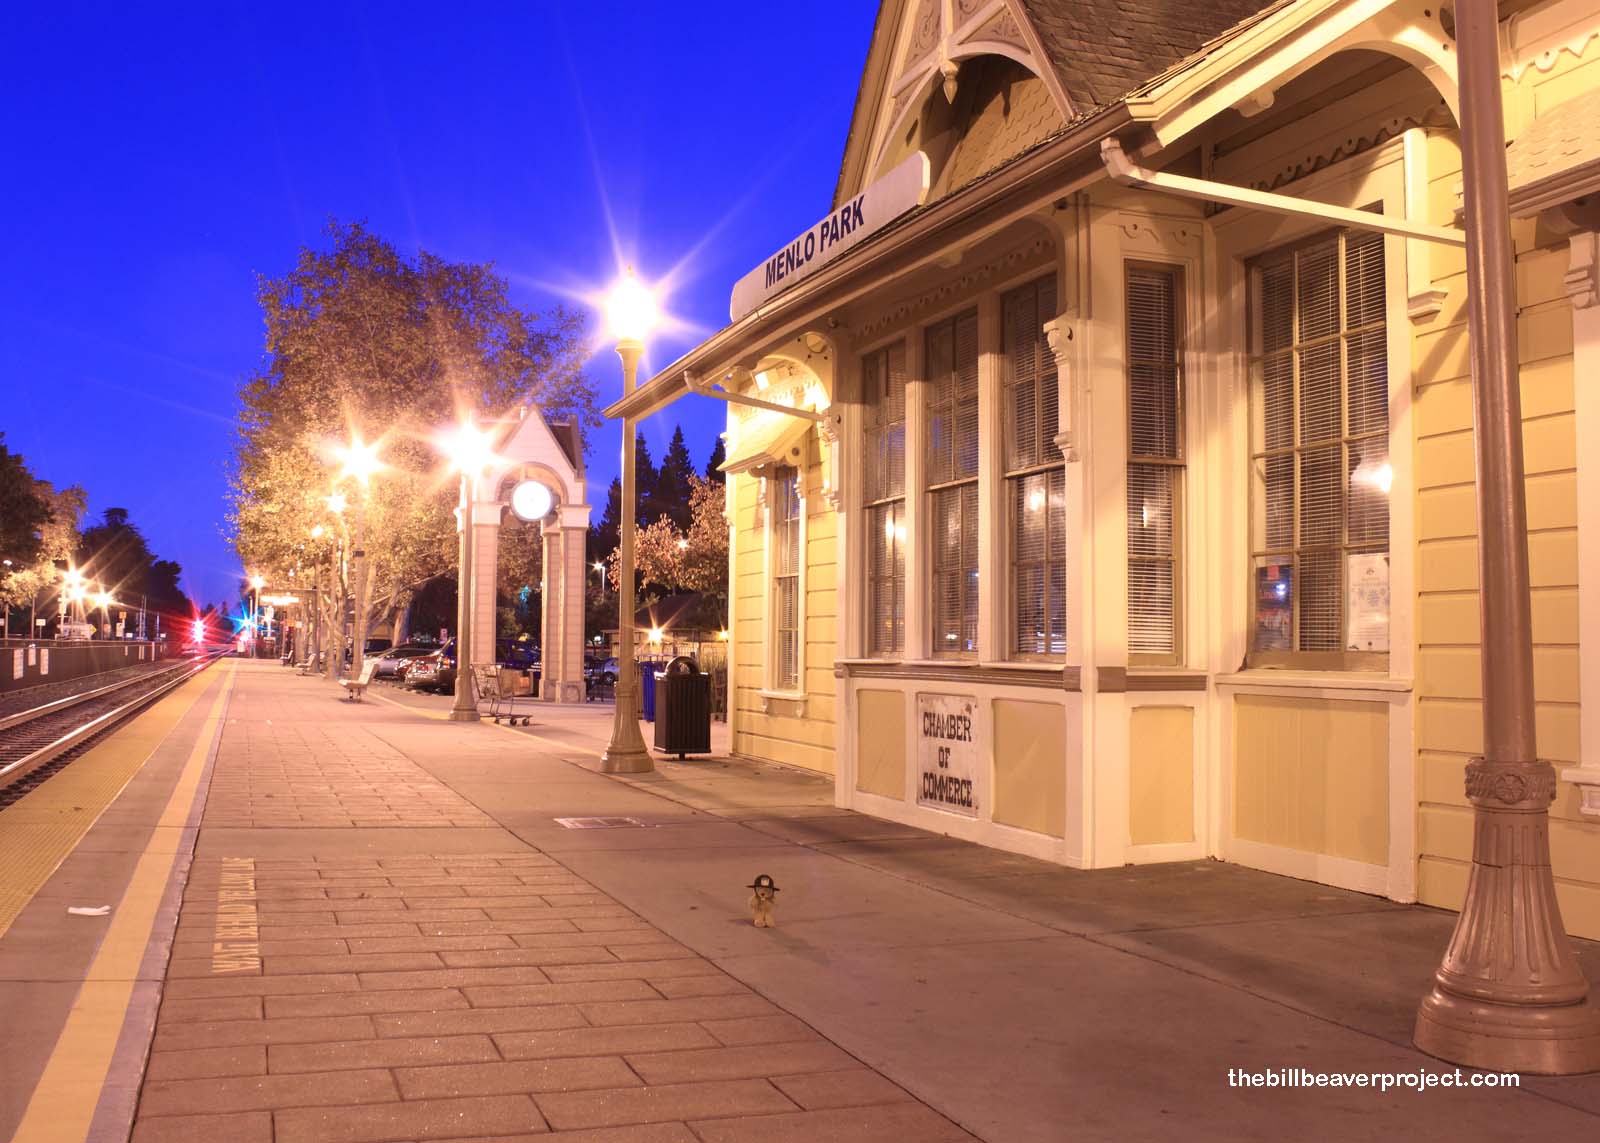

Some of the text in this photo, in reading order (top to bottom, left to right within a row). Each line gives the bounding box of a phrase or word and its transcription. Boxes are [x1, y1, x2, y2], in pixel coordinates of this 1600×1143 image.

[765, 195, 865, 288] MENLO PARK
[923, 712, 972, 742] CHAMBER
[938, 746, 951, 768] OF
[923, 772, 972, 808] COMMERCE
[218, 873, 256, 902] YELLOW
[215, 904, 259, 939] BEHIND
[211, 942, 261, 973] WAIT
